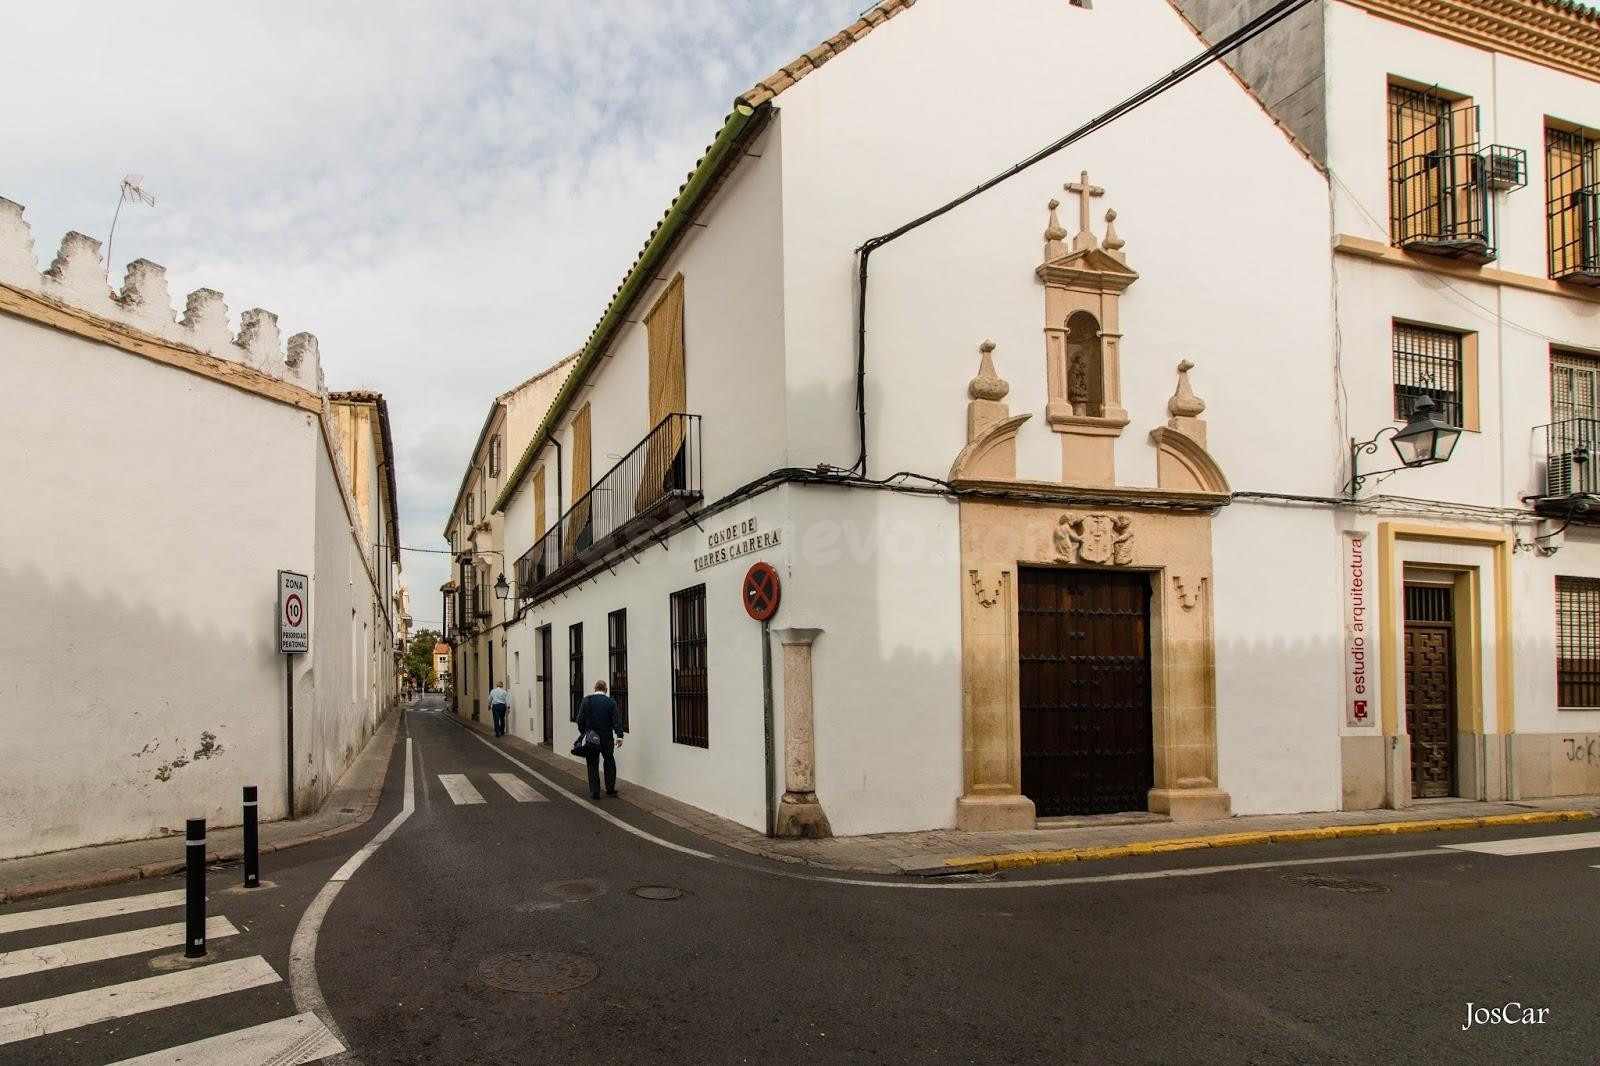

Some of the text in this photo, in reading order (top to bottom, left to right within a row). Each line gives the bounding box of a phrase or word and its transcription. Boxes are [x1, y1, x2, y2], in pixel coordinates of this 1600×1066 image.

[708, 518, 754, 547] CONDE DE
[694, 530, 779, 570] TORRES CABRERA
[285, 578, 303, 591] ZONA
[289, 604, 299, 617] 10
[1350, 538, 1366, 695] estudio arquitectura
